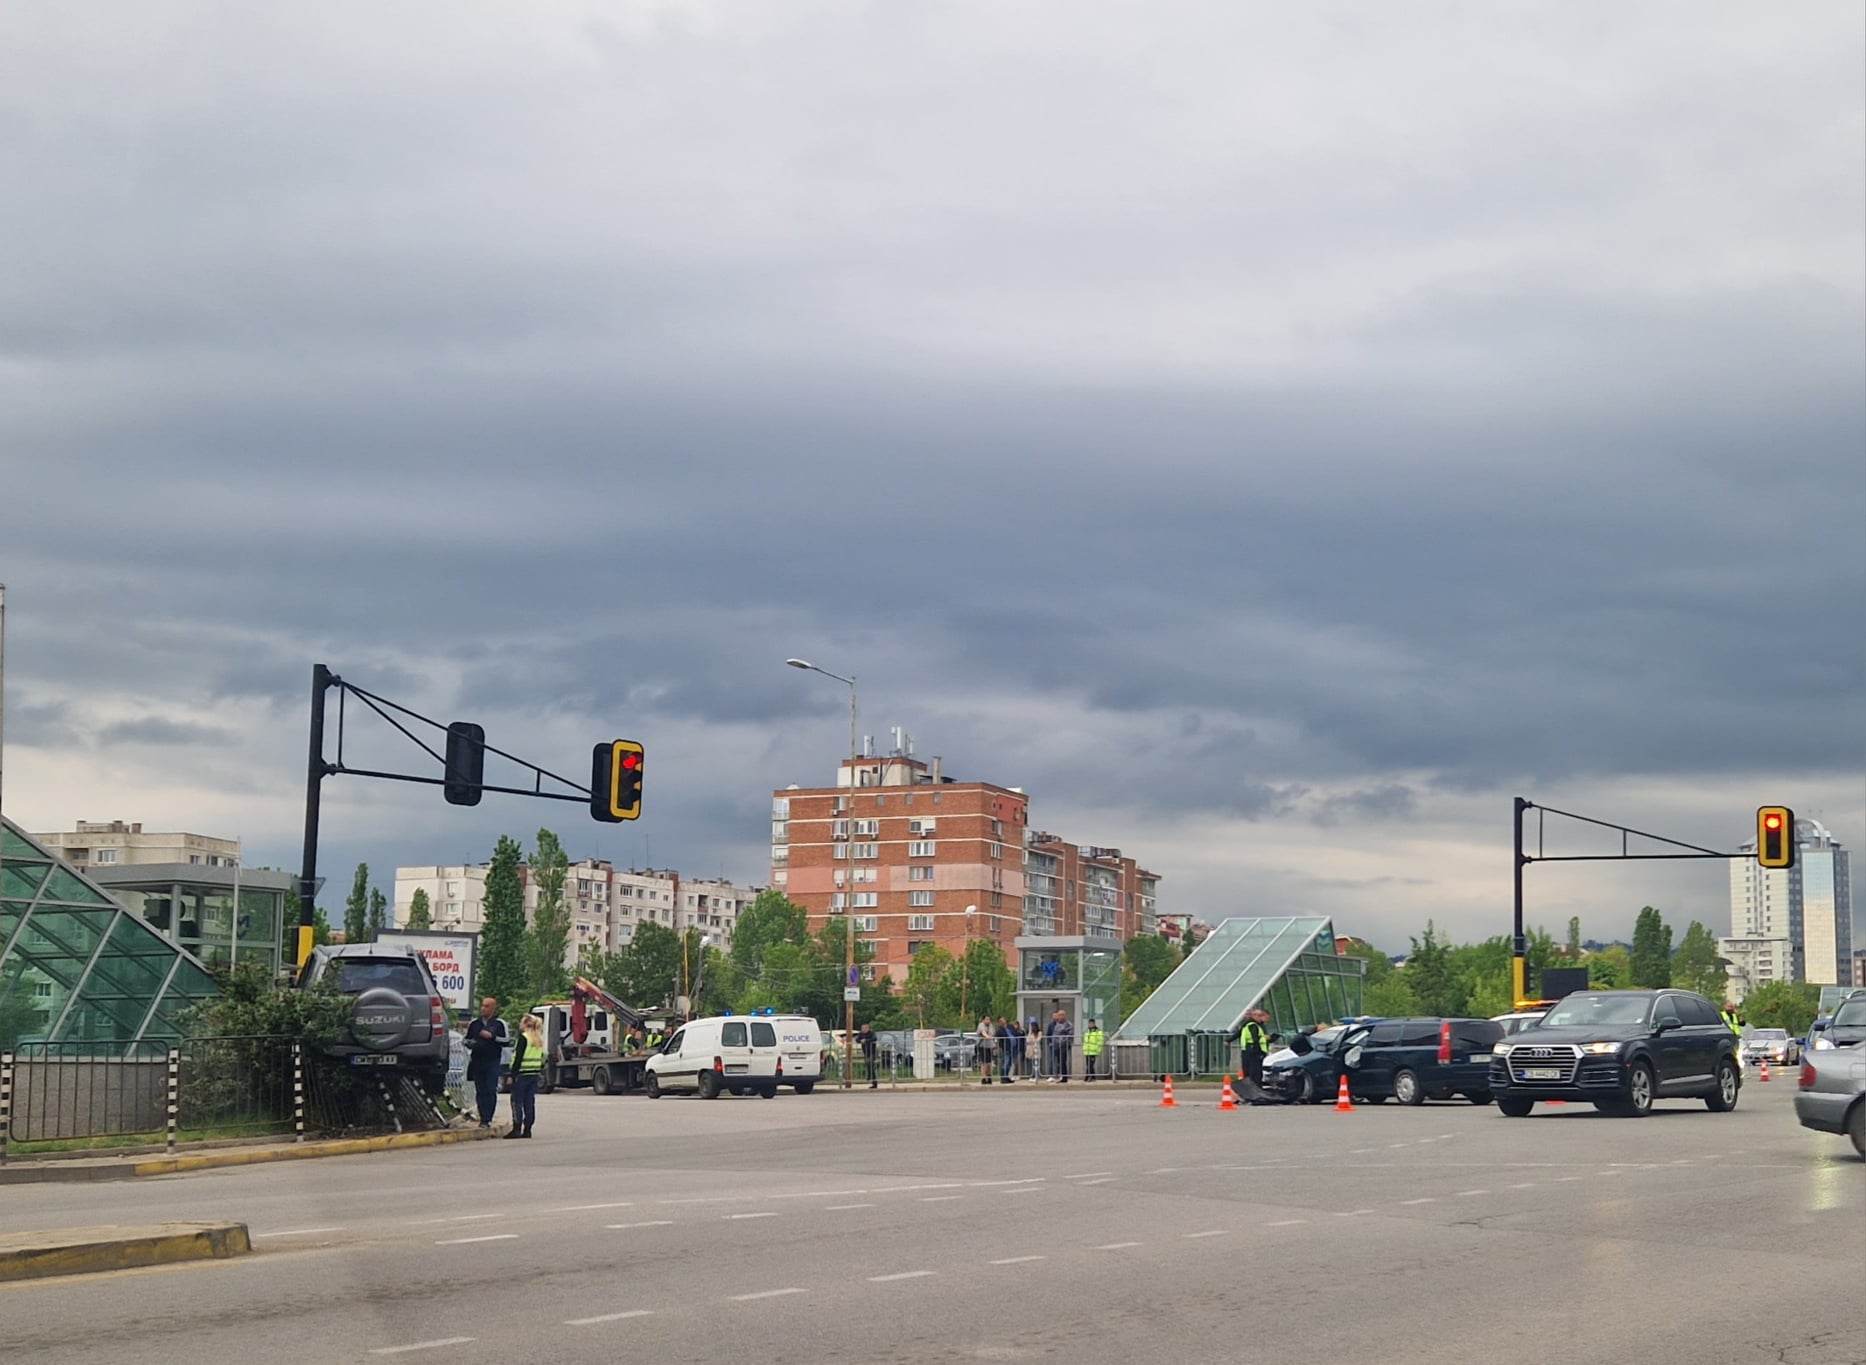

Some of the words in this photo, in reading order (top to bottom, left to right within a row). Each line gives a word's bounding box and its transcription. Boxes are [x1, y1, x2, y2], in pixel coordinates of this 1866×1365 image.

[432, 963, 459, 972] БОРД
[442, 975, 464, 990] 600
[355, 1016, 405, 1025] SUZUKI
